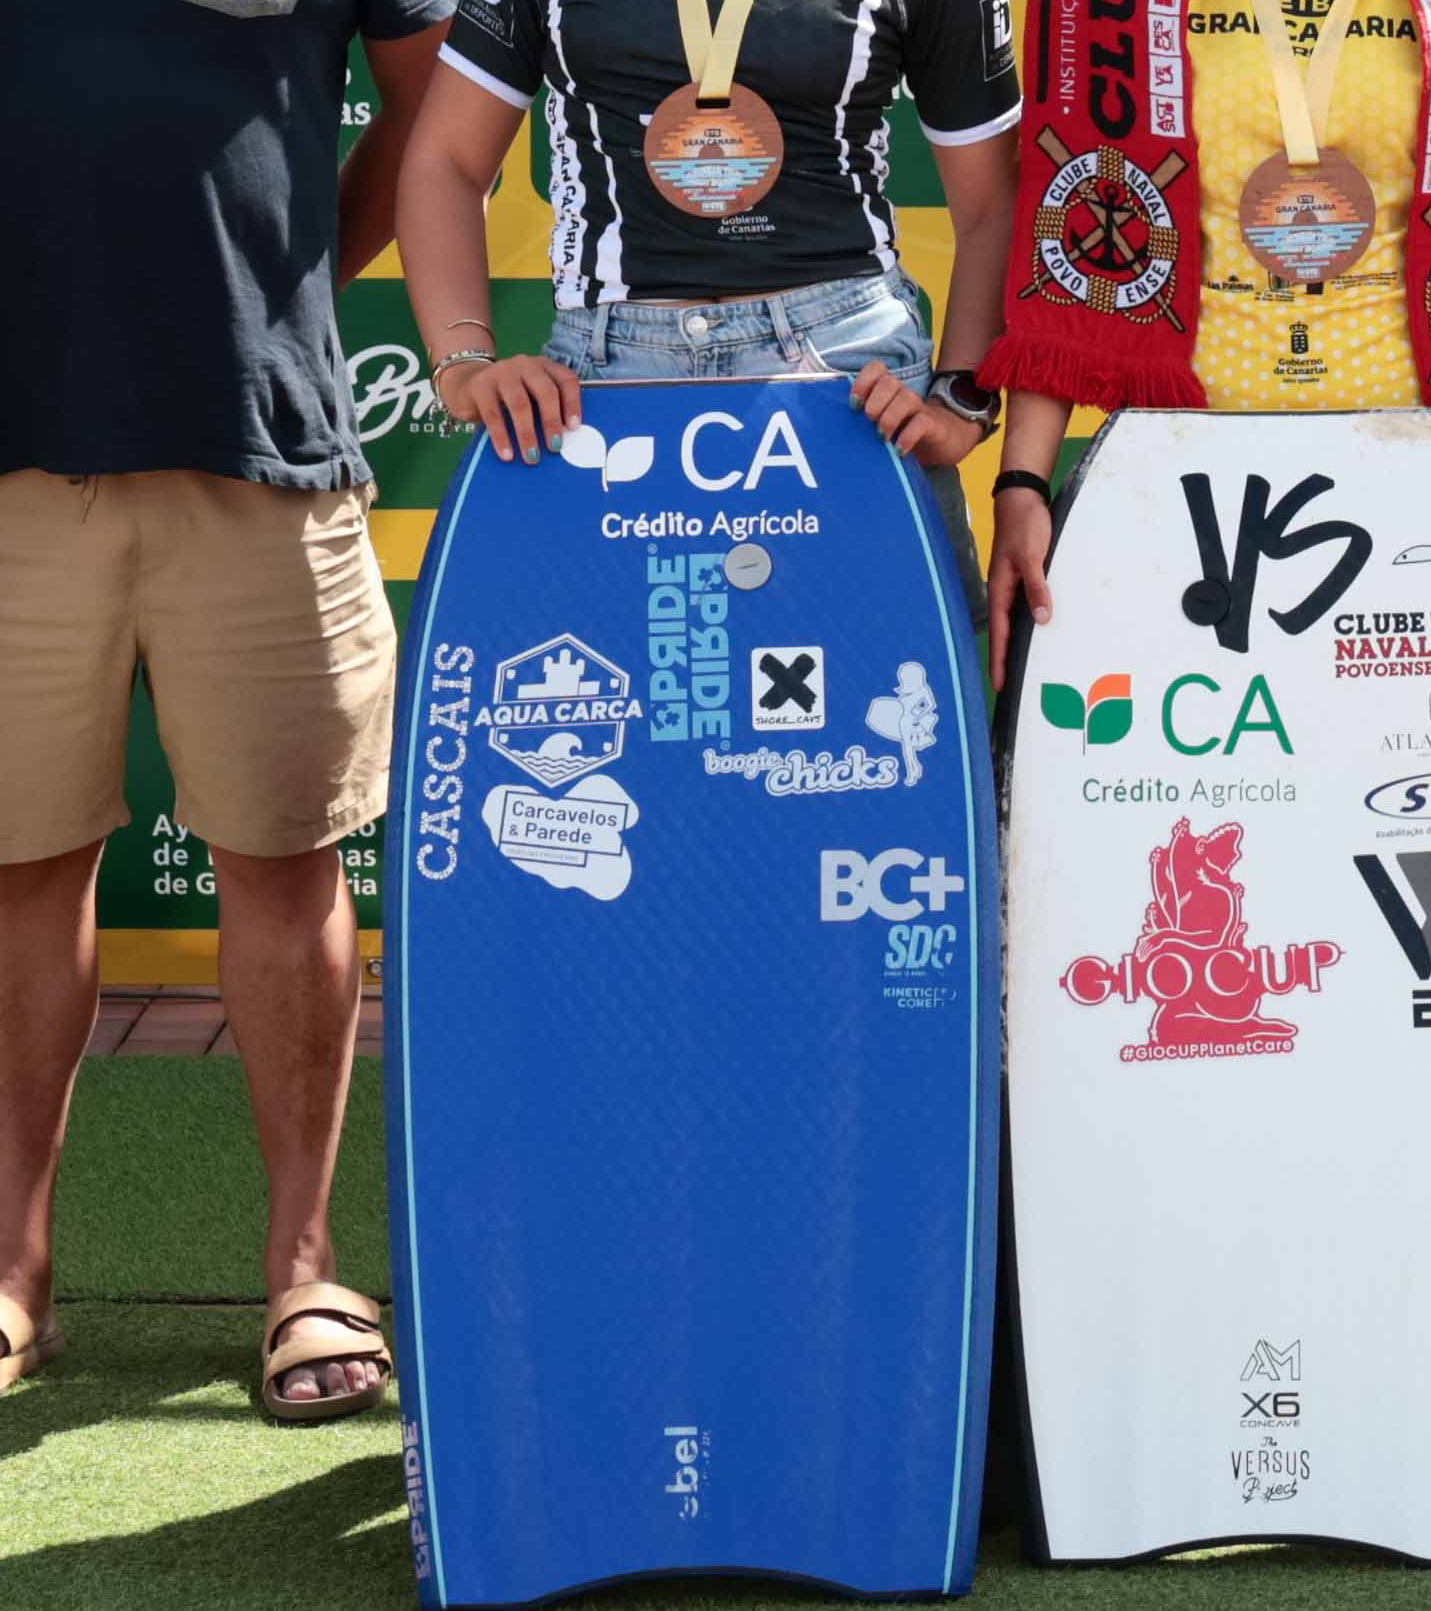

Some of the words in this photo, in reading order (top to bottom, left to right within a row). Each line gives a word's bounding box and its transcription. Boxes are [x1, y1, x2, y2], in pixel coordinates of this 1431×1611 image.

[1050, 158, 1093, 201] CLUBE
[1128, 168, 1166, 223] NAVAL
[1045, 246, 1082, 291] POVO
[1126, 263, 1166, 302] ENSE
[681, 410, 818, 491] CA
[602, 511, 703, 540] Crédito
[709, 510, 819, 542] Agrícola
[1334, 613, 1425, 636] CLUBE
[474, 702, 548, 727] AQUA
[554, 699, 643, 722] CARCA
[1161, 674, 1295, 755] CA
[416, 642, 475, 881] CASCAIS
[1083, 778, 1180, 804] Crédito
[1191, 775, 1296, 809] Agrícola
[512, 800, 618, 827] Carcavelos
[508, 824, 519, 838] &
[524, 823, 592, 845] Parede
[1065, 942, 1342, 1005] GIOCUP
[1241, 1392, 1300, 1418] X6
[1240, 1420, 1300, 1428] CONCAVE
[1231, 1450, 1311, 1480] VERSUS
